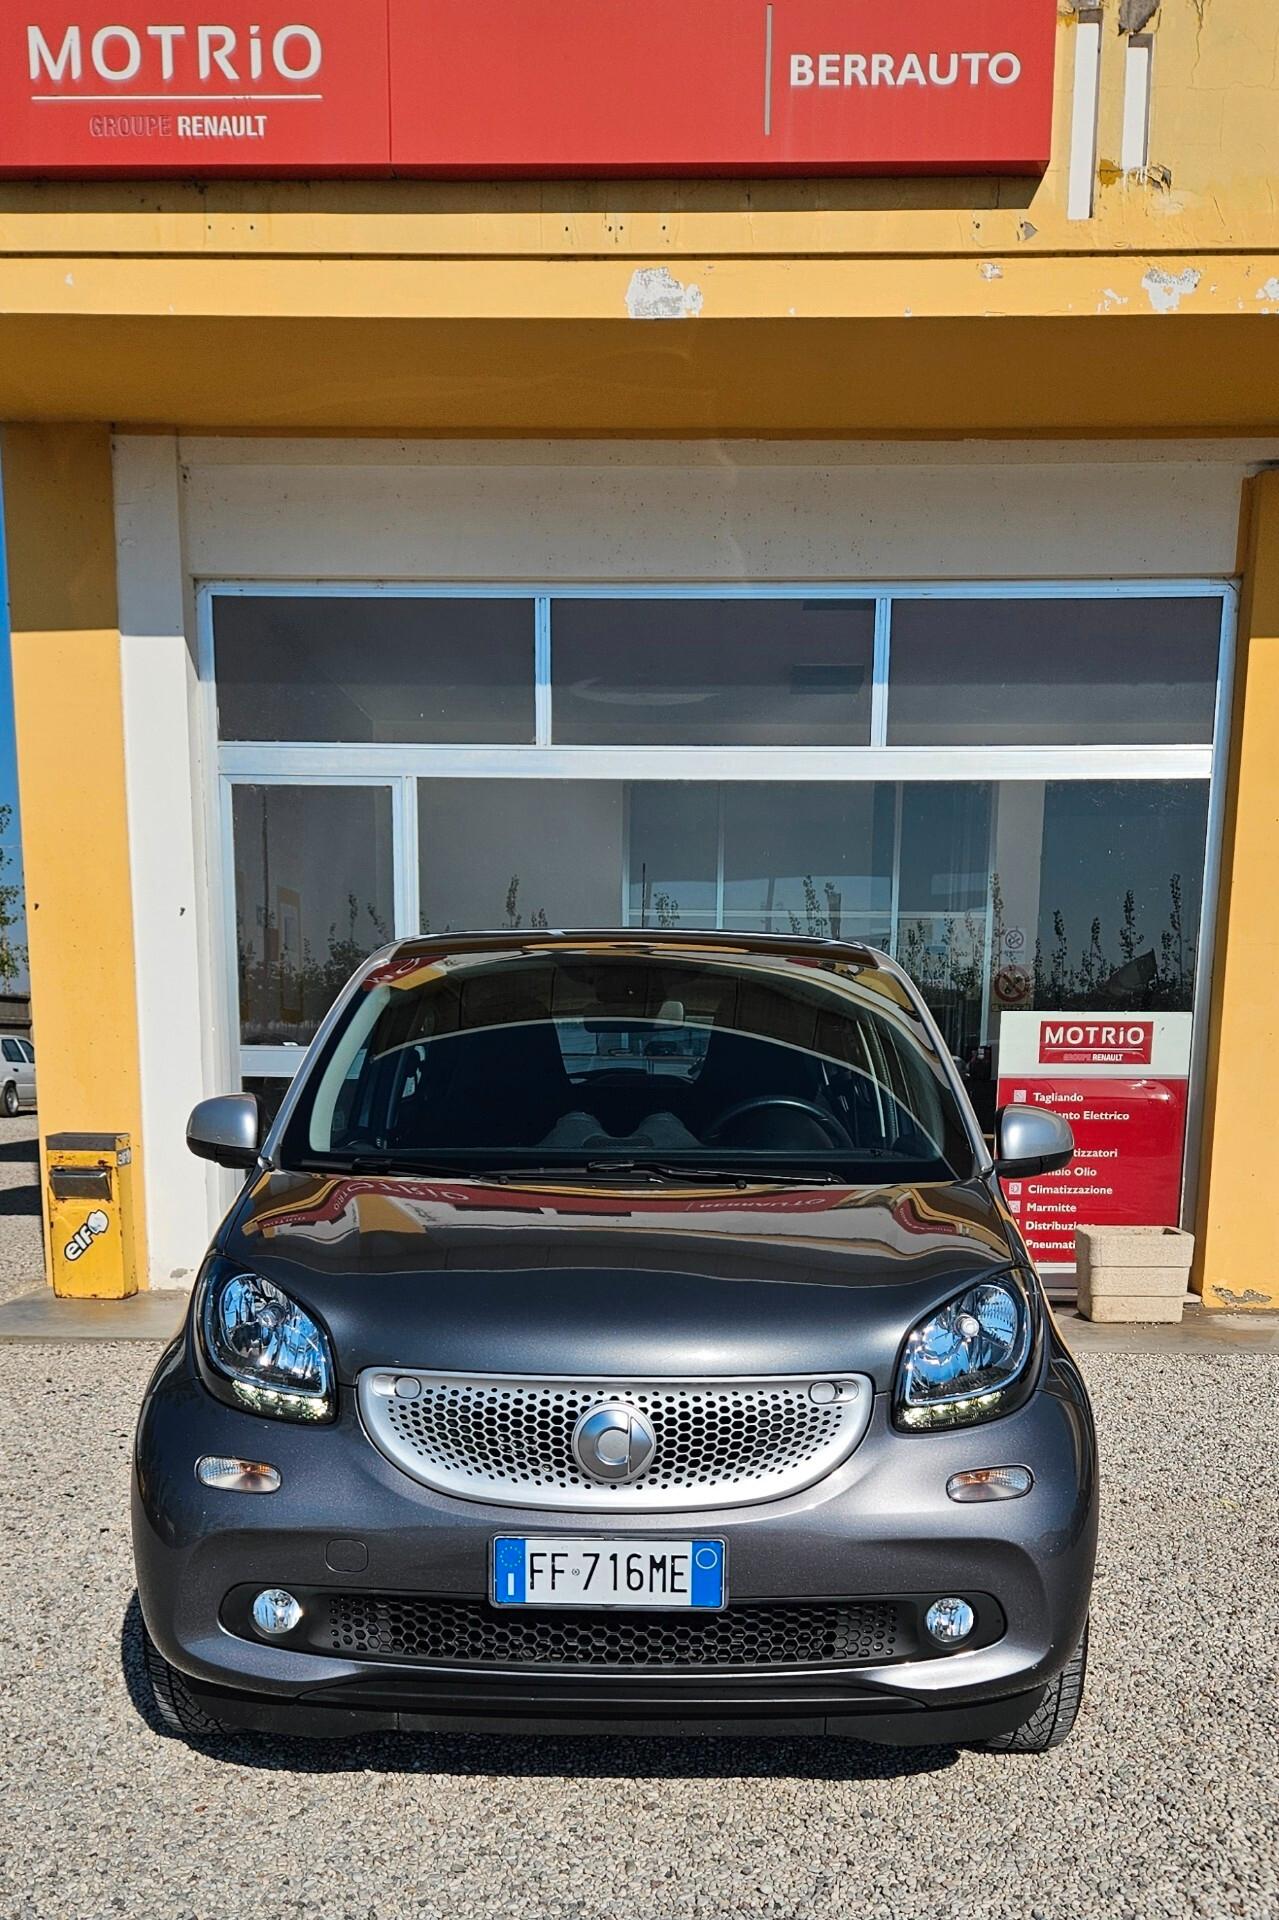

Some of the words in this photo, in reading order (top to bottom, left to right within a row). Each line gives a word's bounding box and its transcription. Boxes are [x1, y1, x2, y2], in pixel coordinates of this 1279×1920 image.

[790, 52, 1021, 86] BERRAUTO
[90, 115, 172, 136] GROUPE
[178, 115, 267, 136] RENAULT
[1092, 1053, 1123, 1061] RENAULT
[1033, 1092, 1084, 1104] Tagliando
[1083, 1110, 1130, 1120] Elettrico
[1073, 1148, 1118, 1158] tizzatori
[1074, 1167, 1097, 1177] Olio
[1028, 1184, 1113, 1194] Climatizzazione
[1026, 1203, 1077, 1212] Marmitte
[64, 1224, 93, 1261] elf
